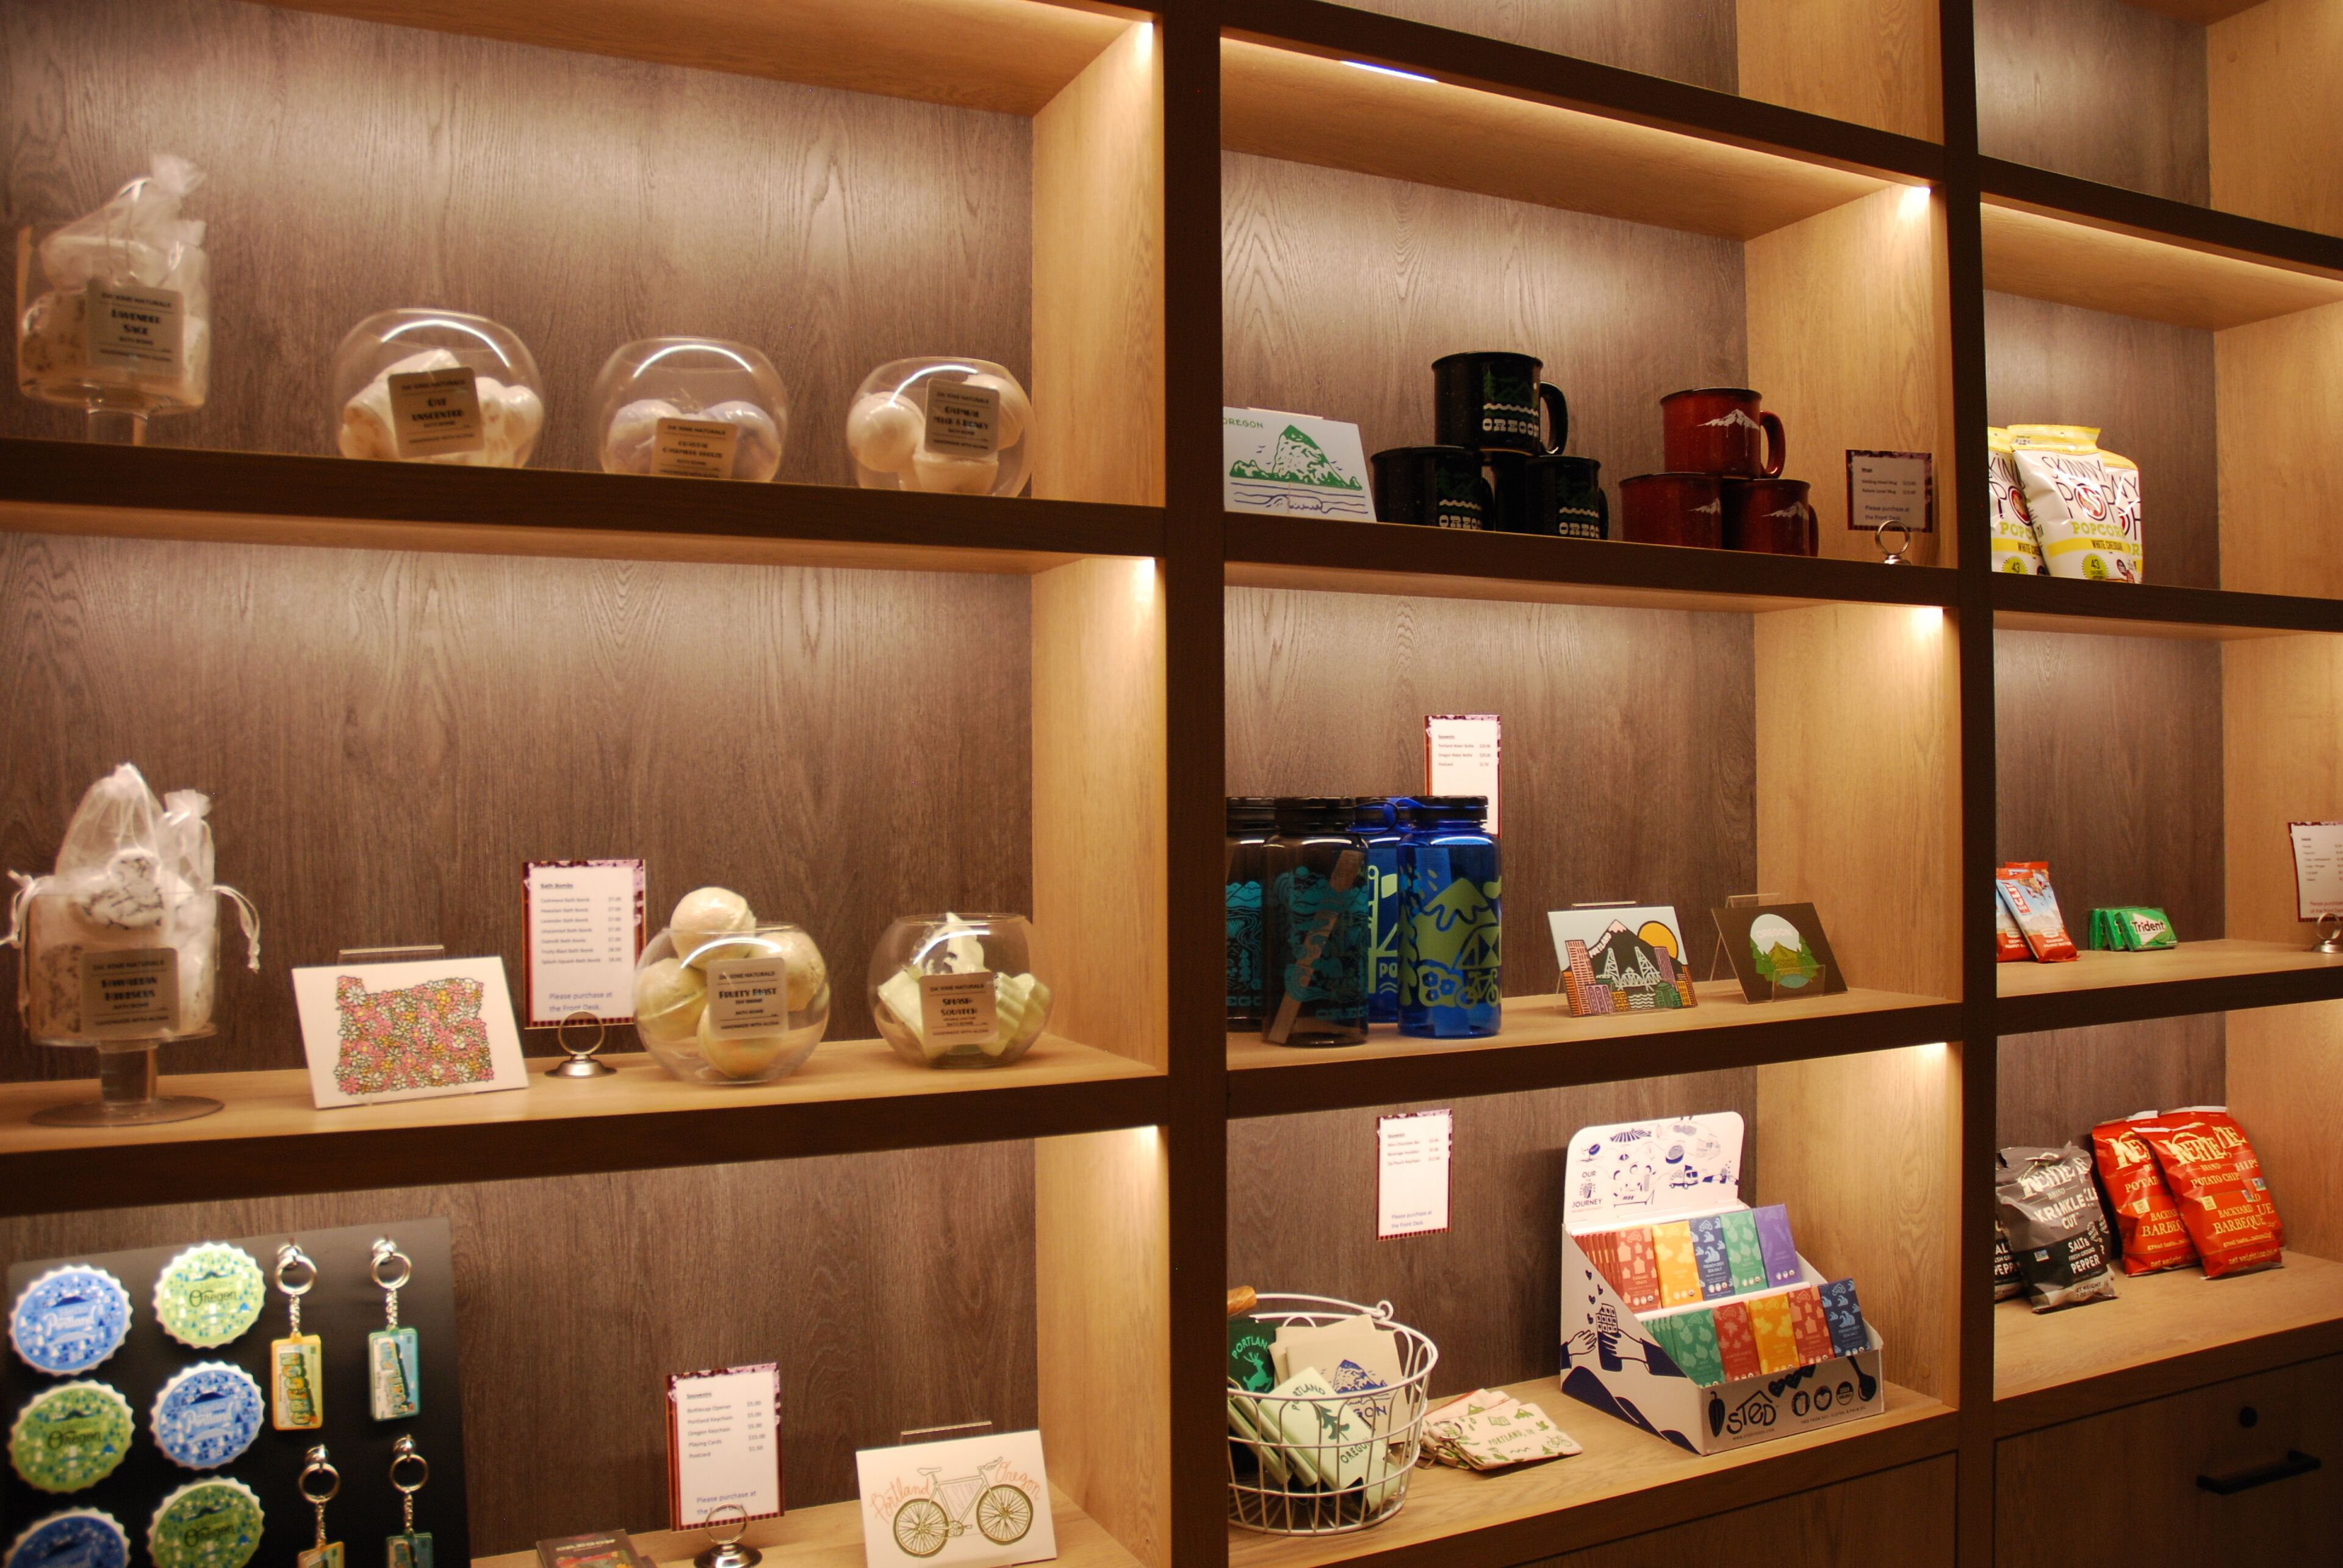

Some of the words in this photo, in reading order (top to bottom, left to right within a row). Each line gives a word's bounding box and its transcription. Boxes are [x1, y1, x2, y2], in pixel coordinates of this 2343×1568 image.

[412, 410, 463, 420] UNSCENTED
[2091, 539, 2106, 550] WHITE
[2090, 559, 2101, 569] 43
[1757, 928, 1792, 938] OREGON
[2132, 921, 2164, 932] Trident
[1589, 932, 1611, 958] PORTLAND
[719, 990, 750, 999] FRUITY
[752, 988, 777, 996] BLAST
[2159, 1135, 2227, 1167] KETTLE
[2200, 1163, 2221, 1171] BRAND
[2190, 1175, 2222, 1188] POTATO
[1572, 1199, 1602, 1208] JOURNEY
[2034, 1193, 2086, 1222] KRINKLE
[2217, 1204, 2253, 1218] BACKYARD
[2062, 1215, 2078, 1229] CUT
[2142, 1220, 2185, 1237] BARBEQ
[2213, 1215, 2266, 1234] BARBEQUE
[2069, 1253, 2081, 1262] FRESH
[2081, 1247, 2095, 1256] GROUND
[2071, 1254, 2100, 1274] PEPPER
[190, 1289, 237, 1307] Oregon
[42, 1304, 98, 1336] Portland
[1231, 1336, 1269, 1359] PORTLAN
[182, 1401, 234, 1433] Portland
[48, 1430, 102, 1450] Oregon
[719, 1492, 749, 1501] purchase
[870, 1477, 930, 1524] Portland
[995, 1461, 1040, 1500] Oregon
